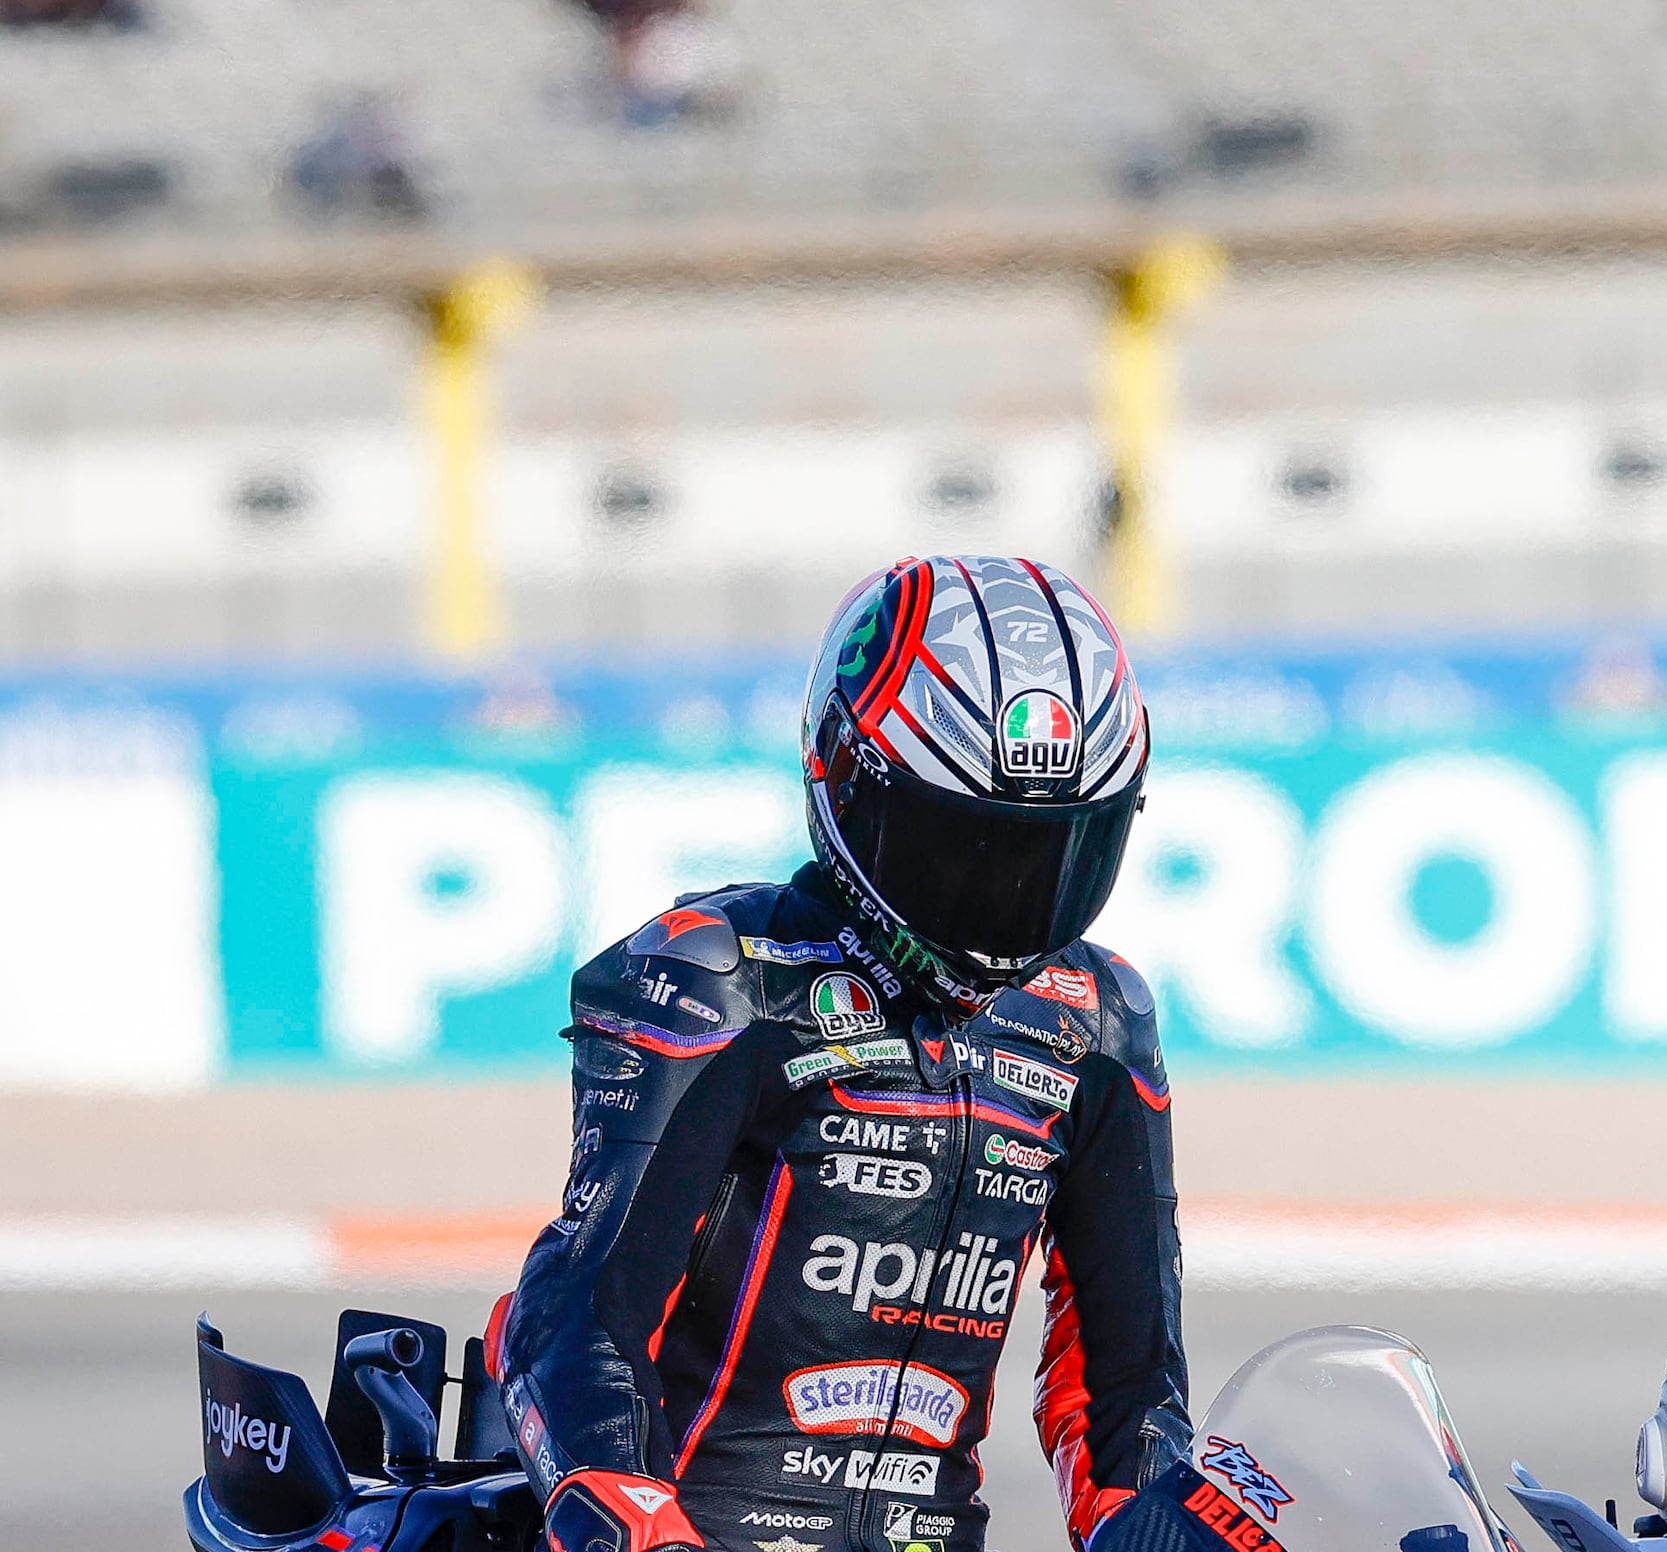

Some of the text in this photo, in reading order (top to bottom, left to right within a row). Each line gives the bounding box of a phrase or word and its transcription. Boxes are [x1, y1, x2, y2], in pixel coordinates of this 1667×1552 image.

[1006, 620, 1050, 643] 72
[1010, 741, 1070, 774] agv
[837, 925, 902, 1001] aprilia
[989, 1013, 1059, 1048] PRAGMATIC
[789, 1043, 906, 1079] Green Power
[998, 1060, 1070, 1102] DELLORTO
[818, 1114, 911, 1152] CAME
[854, 1162, 923, 1192] FES
[974, 1167, 1052, 1206] TARGA
[802, 1231, 1019, 1314] aprilia
[870, 1304, 1006, 1339] RACING
[799, 1367, 957, 1428] sterilgarda
[205, 1387, 292, 1474] joykey
[781, 1446, 845, 1484] sky
[914, 1524, 954, 1537] GROUP
[915, 1513, 956, 1527] PIAGGIO
